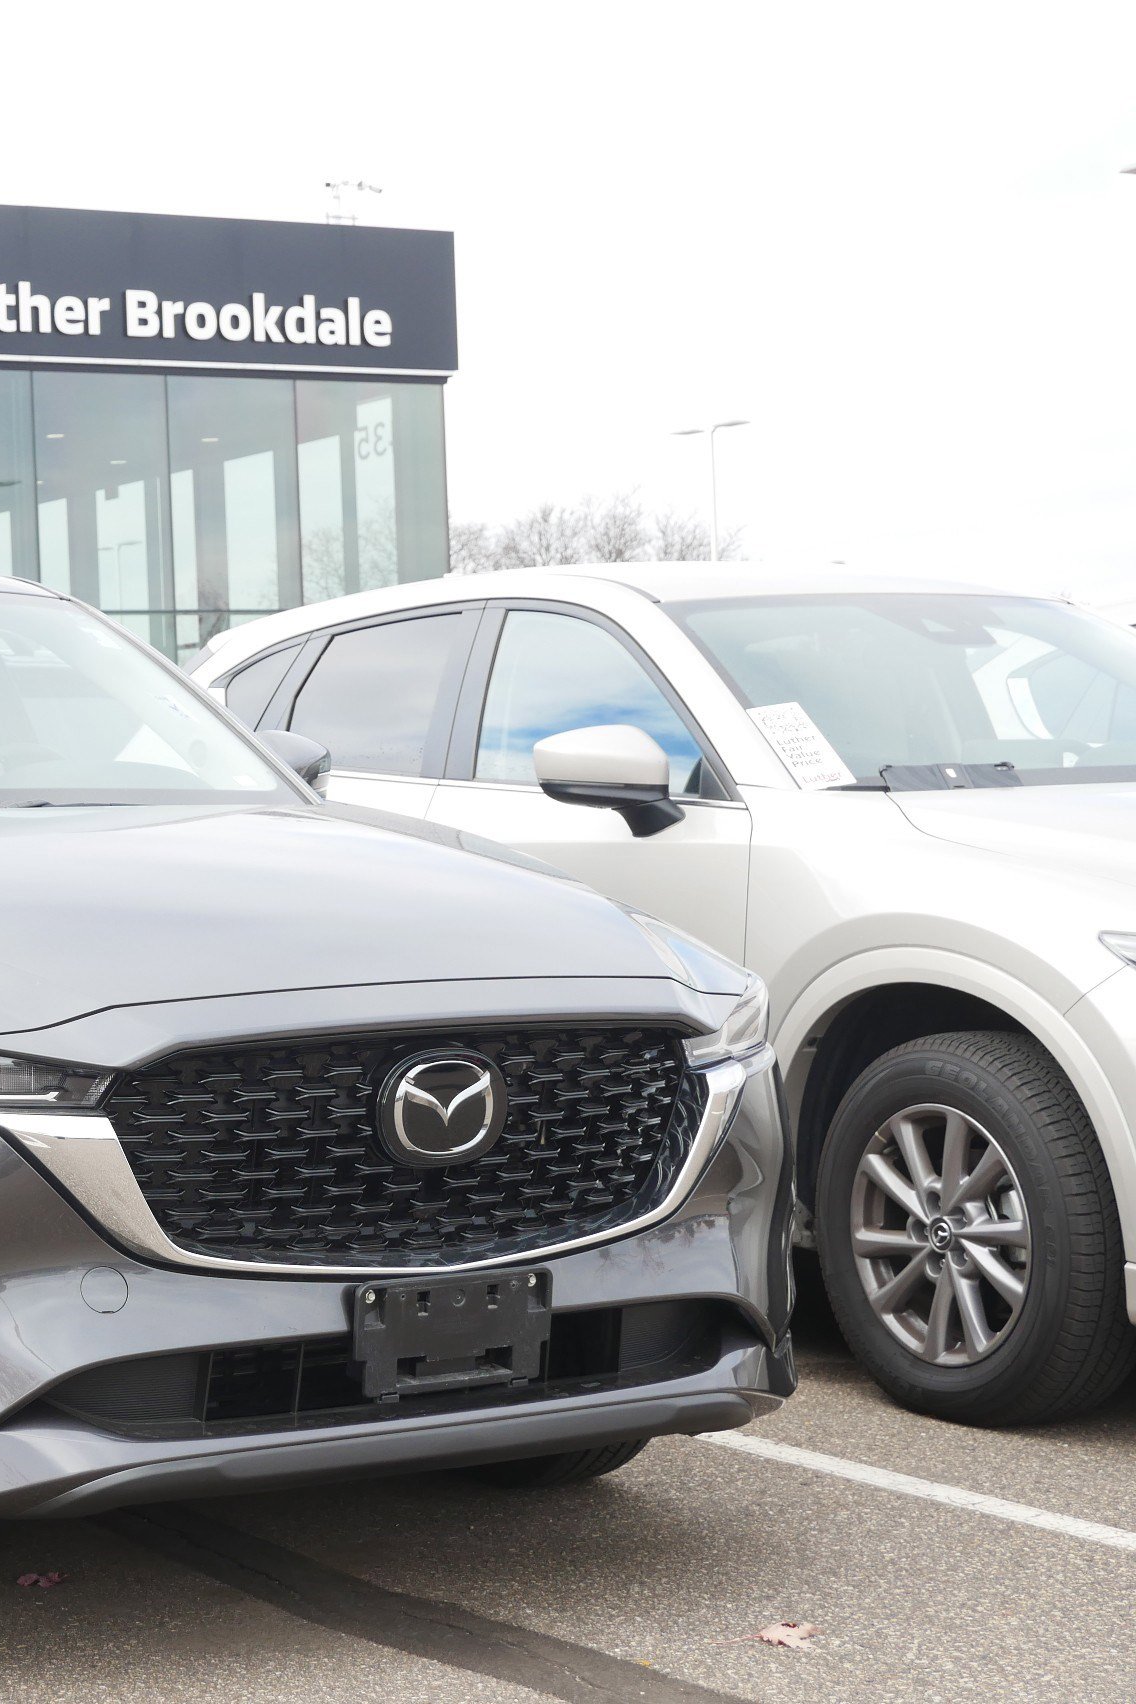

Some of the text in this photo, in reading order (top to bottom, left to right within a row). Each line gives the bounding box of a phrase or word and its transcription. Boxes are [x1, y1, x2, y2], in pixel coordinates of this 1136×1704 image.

[125, 288, 393, 347] Brookdale
[776, 735, 816, 746] Luther
[786, 750, 821, 759] Value
[791, 757, 823, 768] Price
